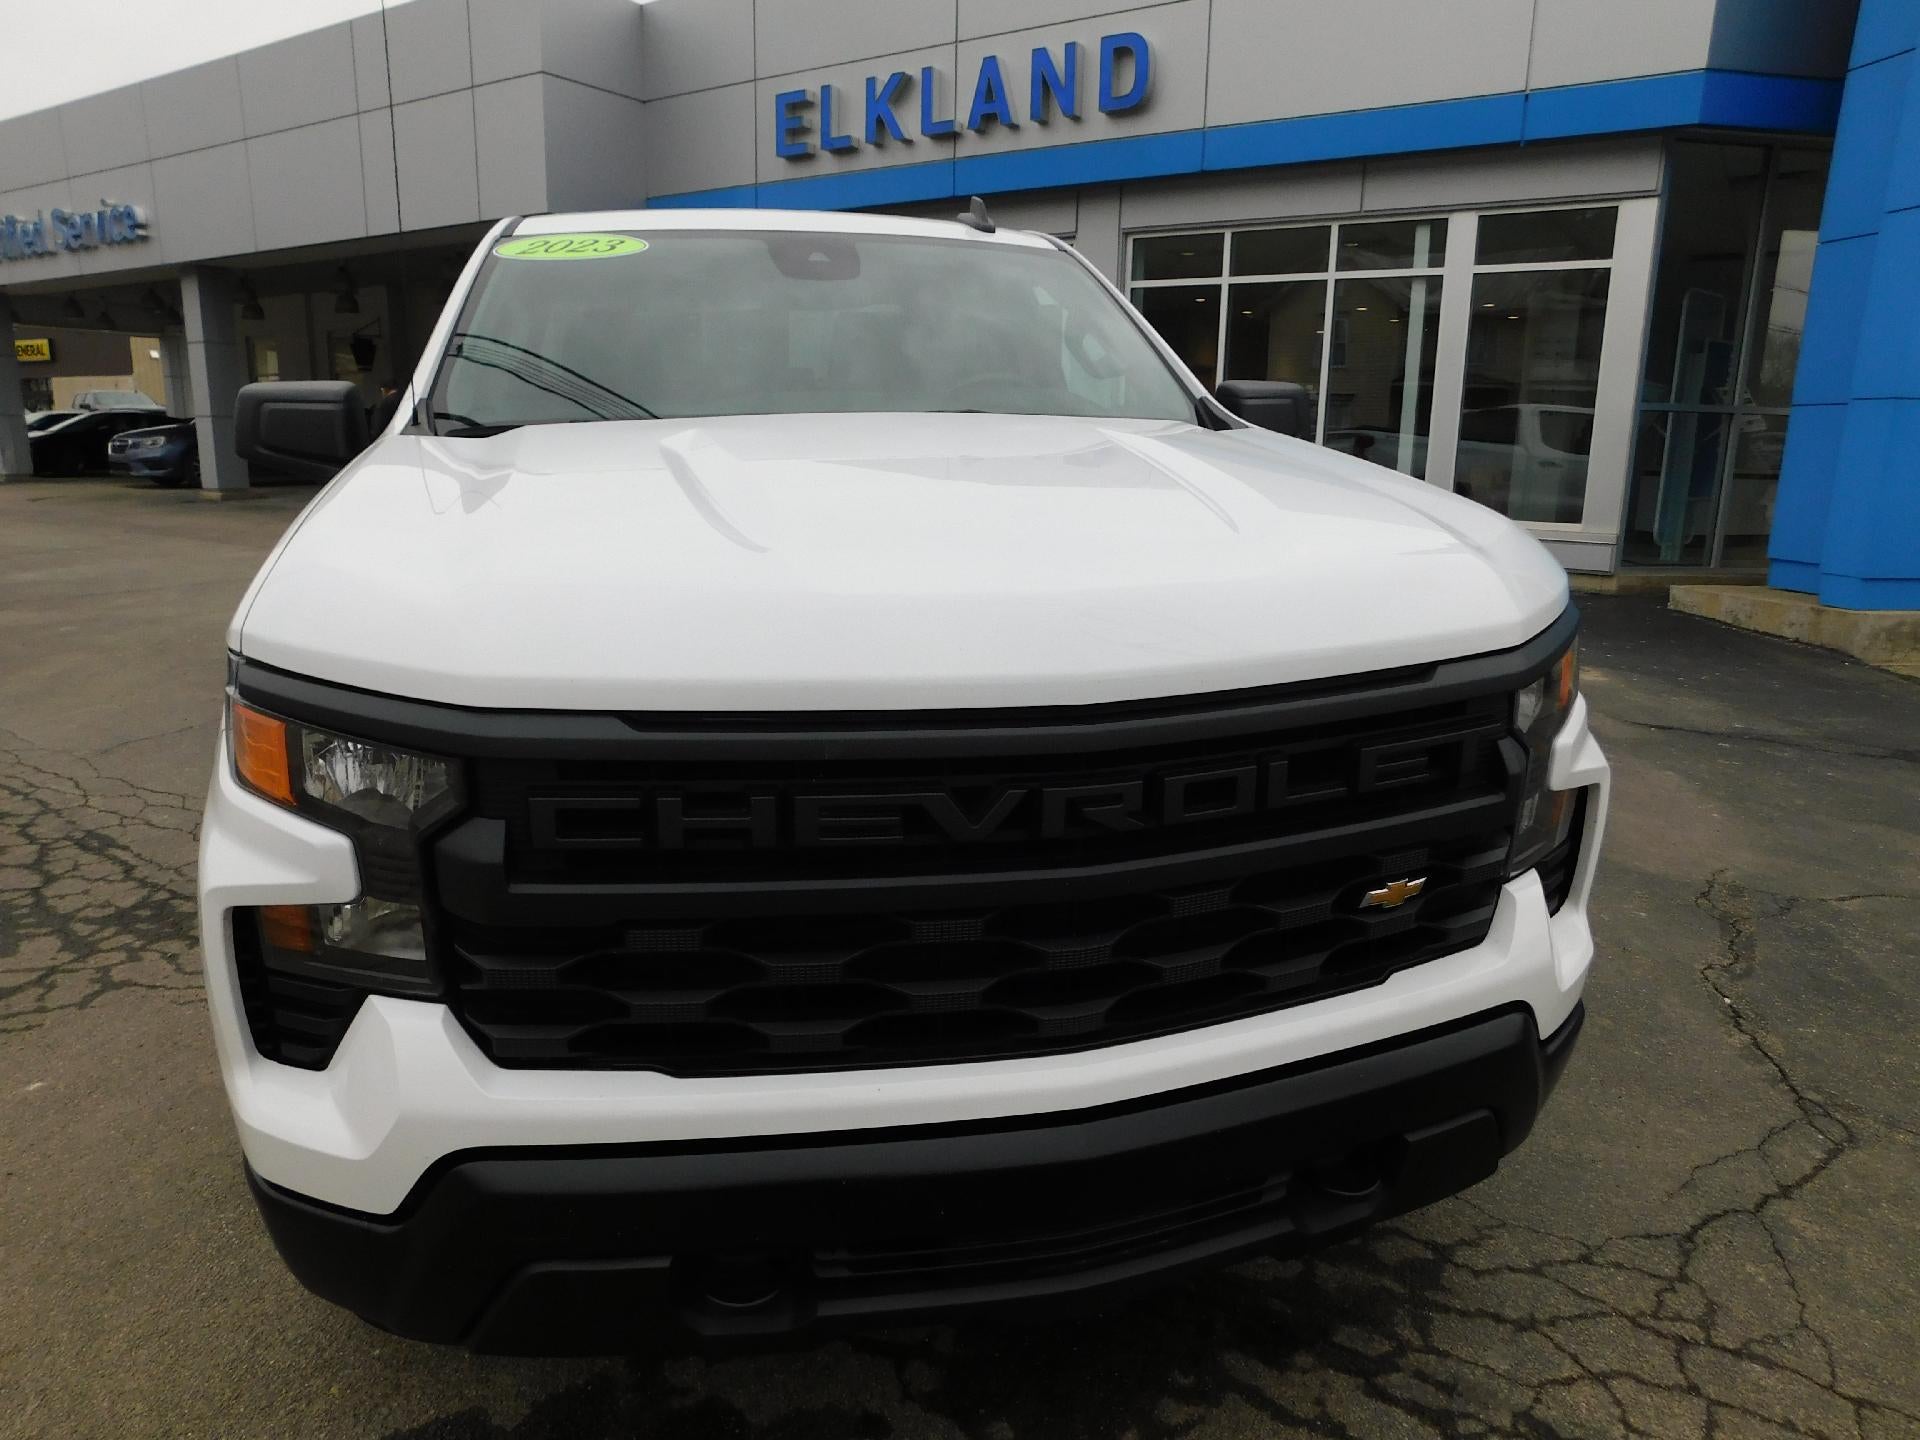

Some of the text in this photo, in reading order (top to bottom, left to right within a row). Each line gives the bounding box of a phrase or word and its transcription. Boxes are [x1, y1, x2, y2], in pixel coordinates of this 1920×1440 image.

[775, 31, 1151, 160] ELKLAND
[51, 199, 146, 249] Service
[515, 238, 626, 255] 2023
[15, 342, 47, 357] ENERAL
[527, 723, 1499, 850] CHEVROLET
